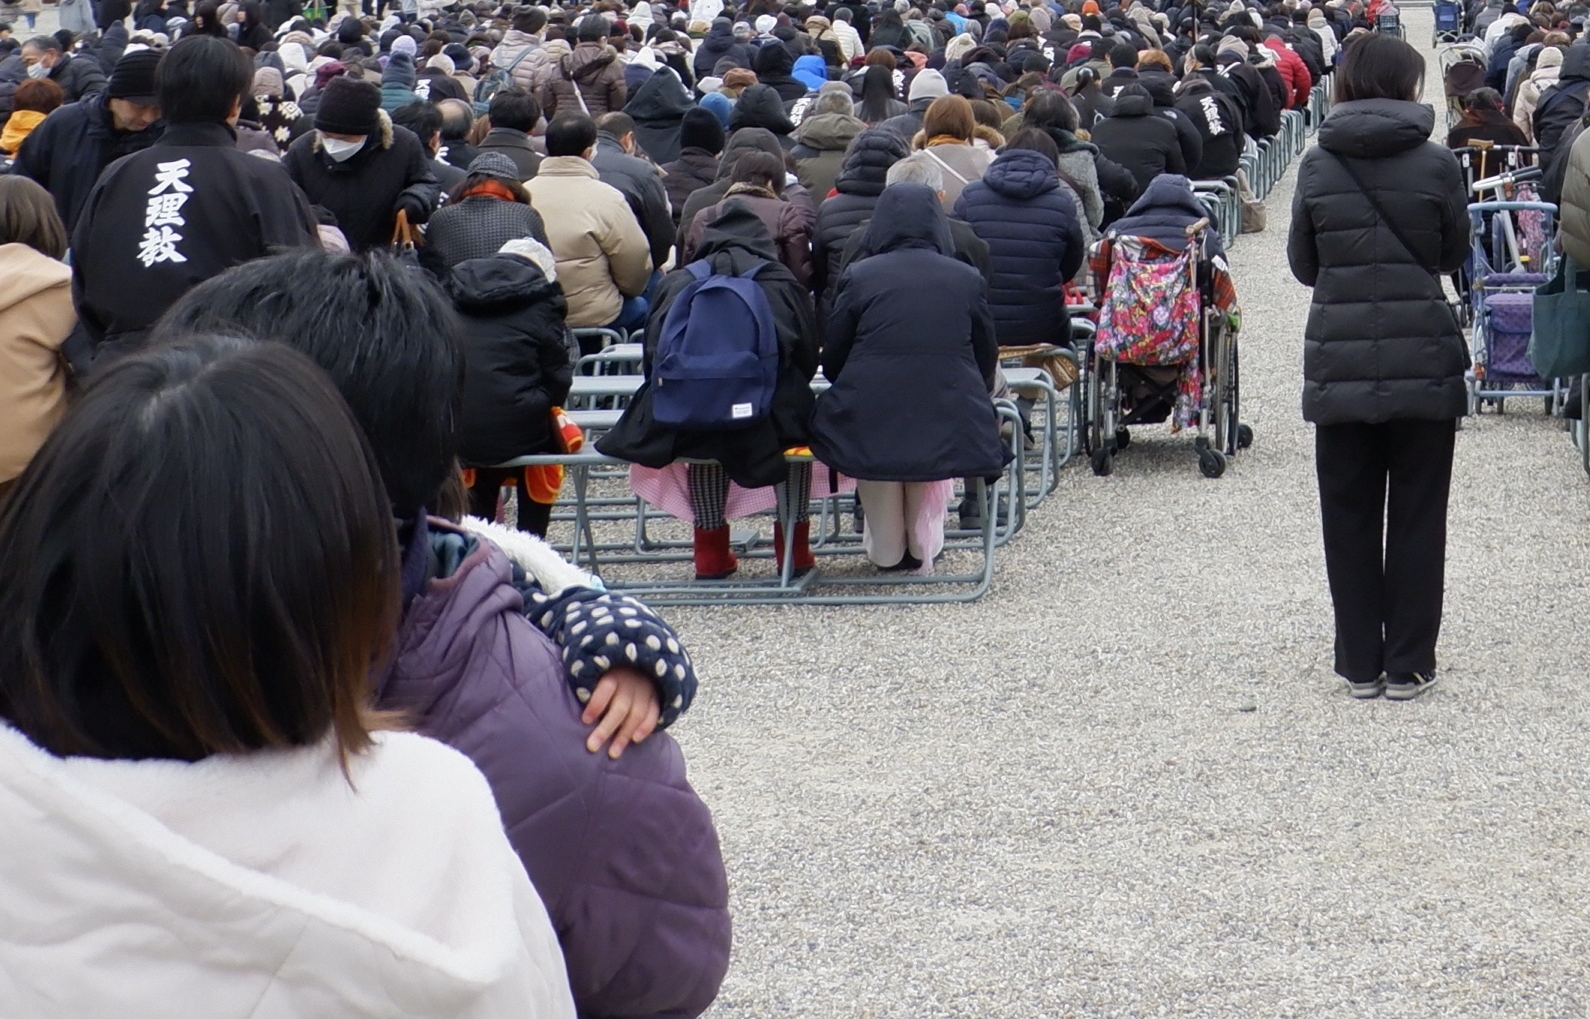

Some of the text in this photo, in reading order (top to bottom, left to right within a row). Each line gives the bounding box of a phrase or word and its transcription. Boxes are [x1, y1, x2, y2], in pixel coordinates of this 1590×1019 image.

[1199, 96, 1226, 136] 天理教
[136, 158, 194, 268] 天理教
